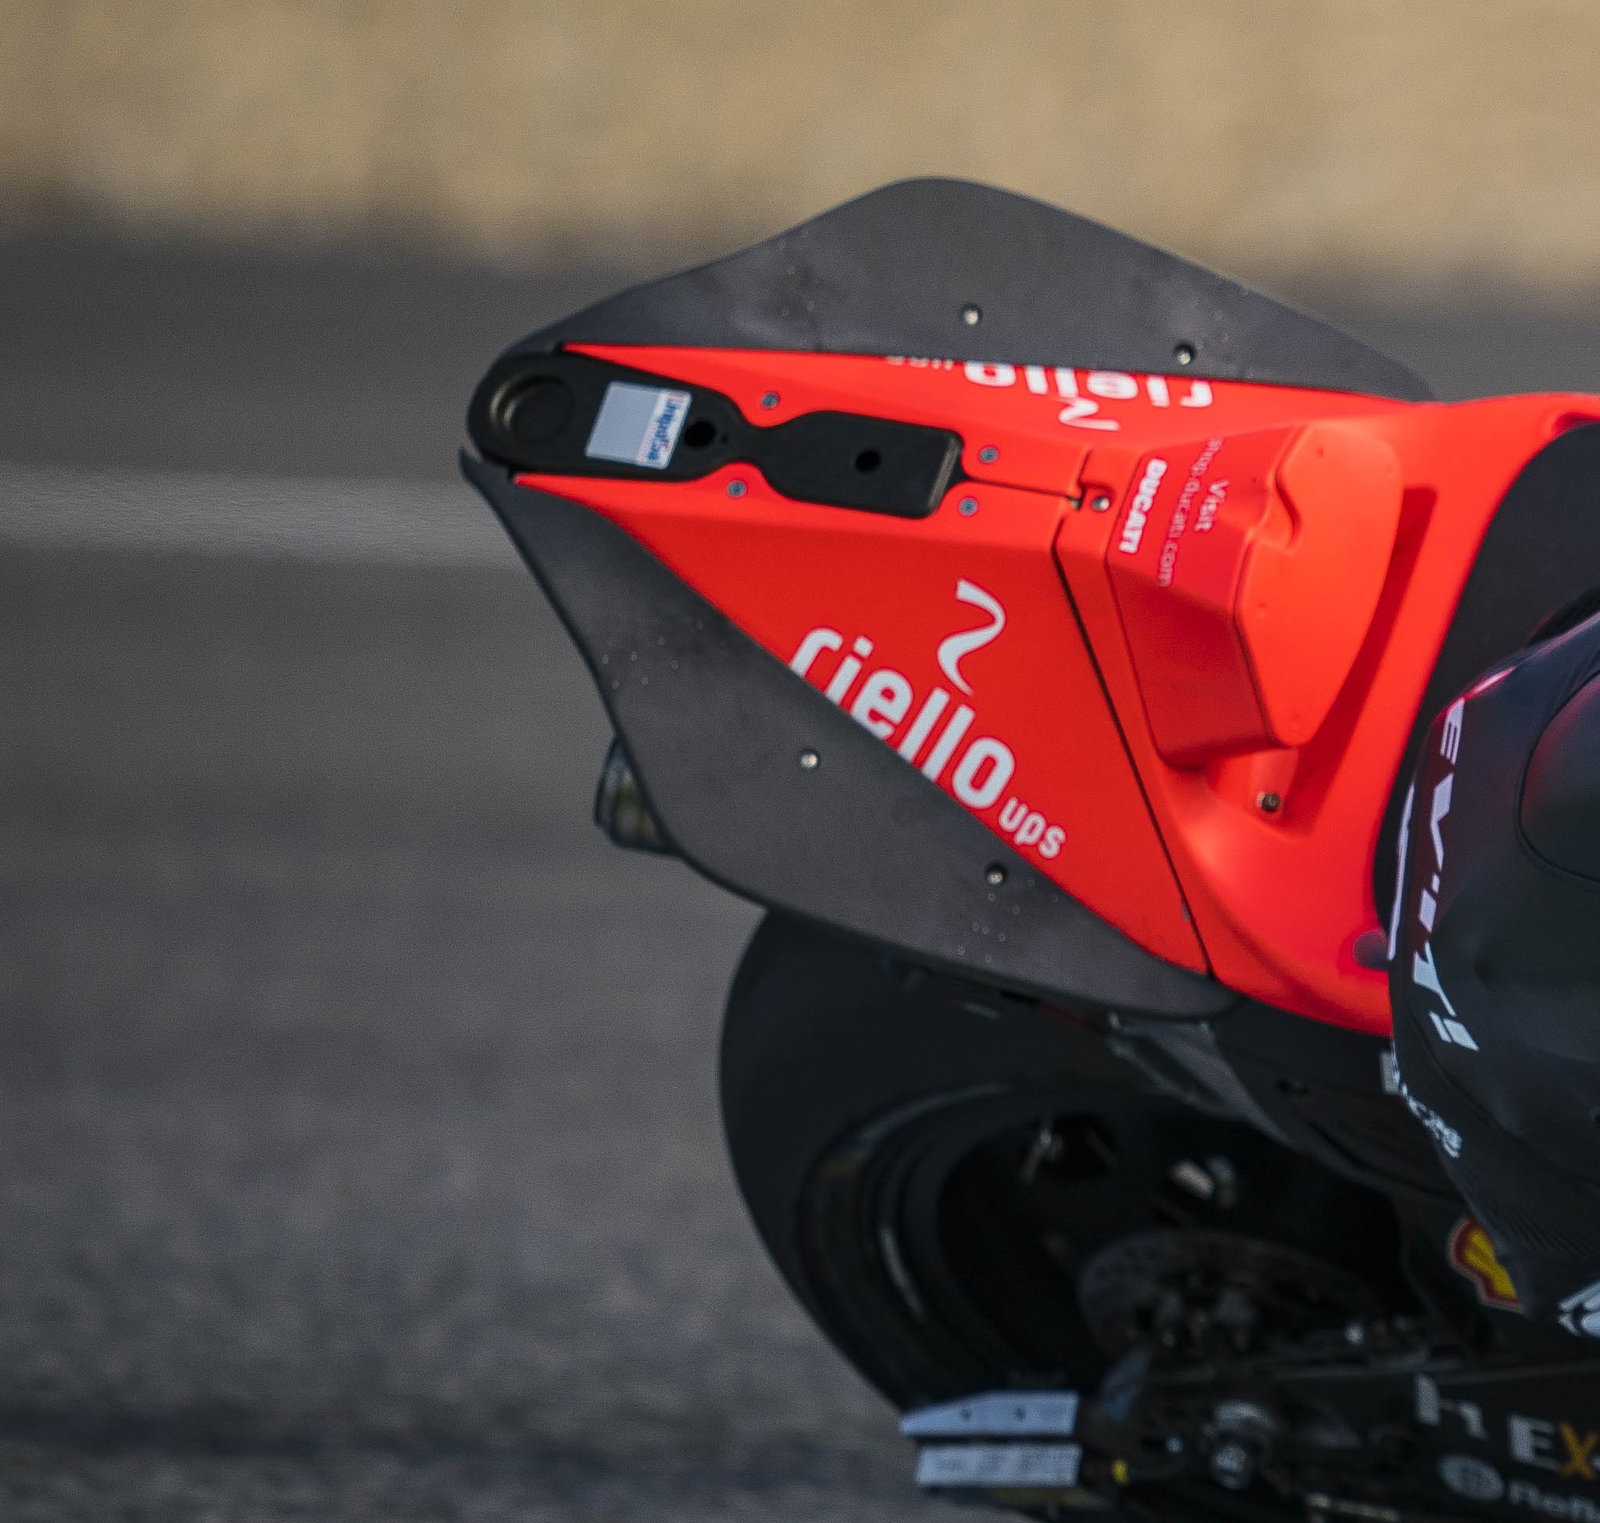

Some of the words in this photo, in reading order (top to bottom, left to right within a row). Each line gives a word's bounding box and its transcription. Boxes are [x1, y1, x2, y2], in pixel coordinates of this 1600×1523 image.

[1118, 458, 1168, 554] DUCATI
[1195, 479, 1230, 533] Visit
[790, 627, 1016, 809] riello
[998, 797, 1068, 859] ups
